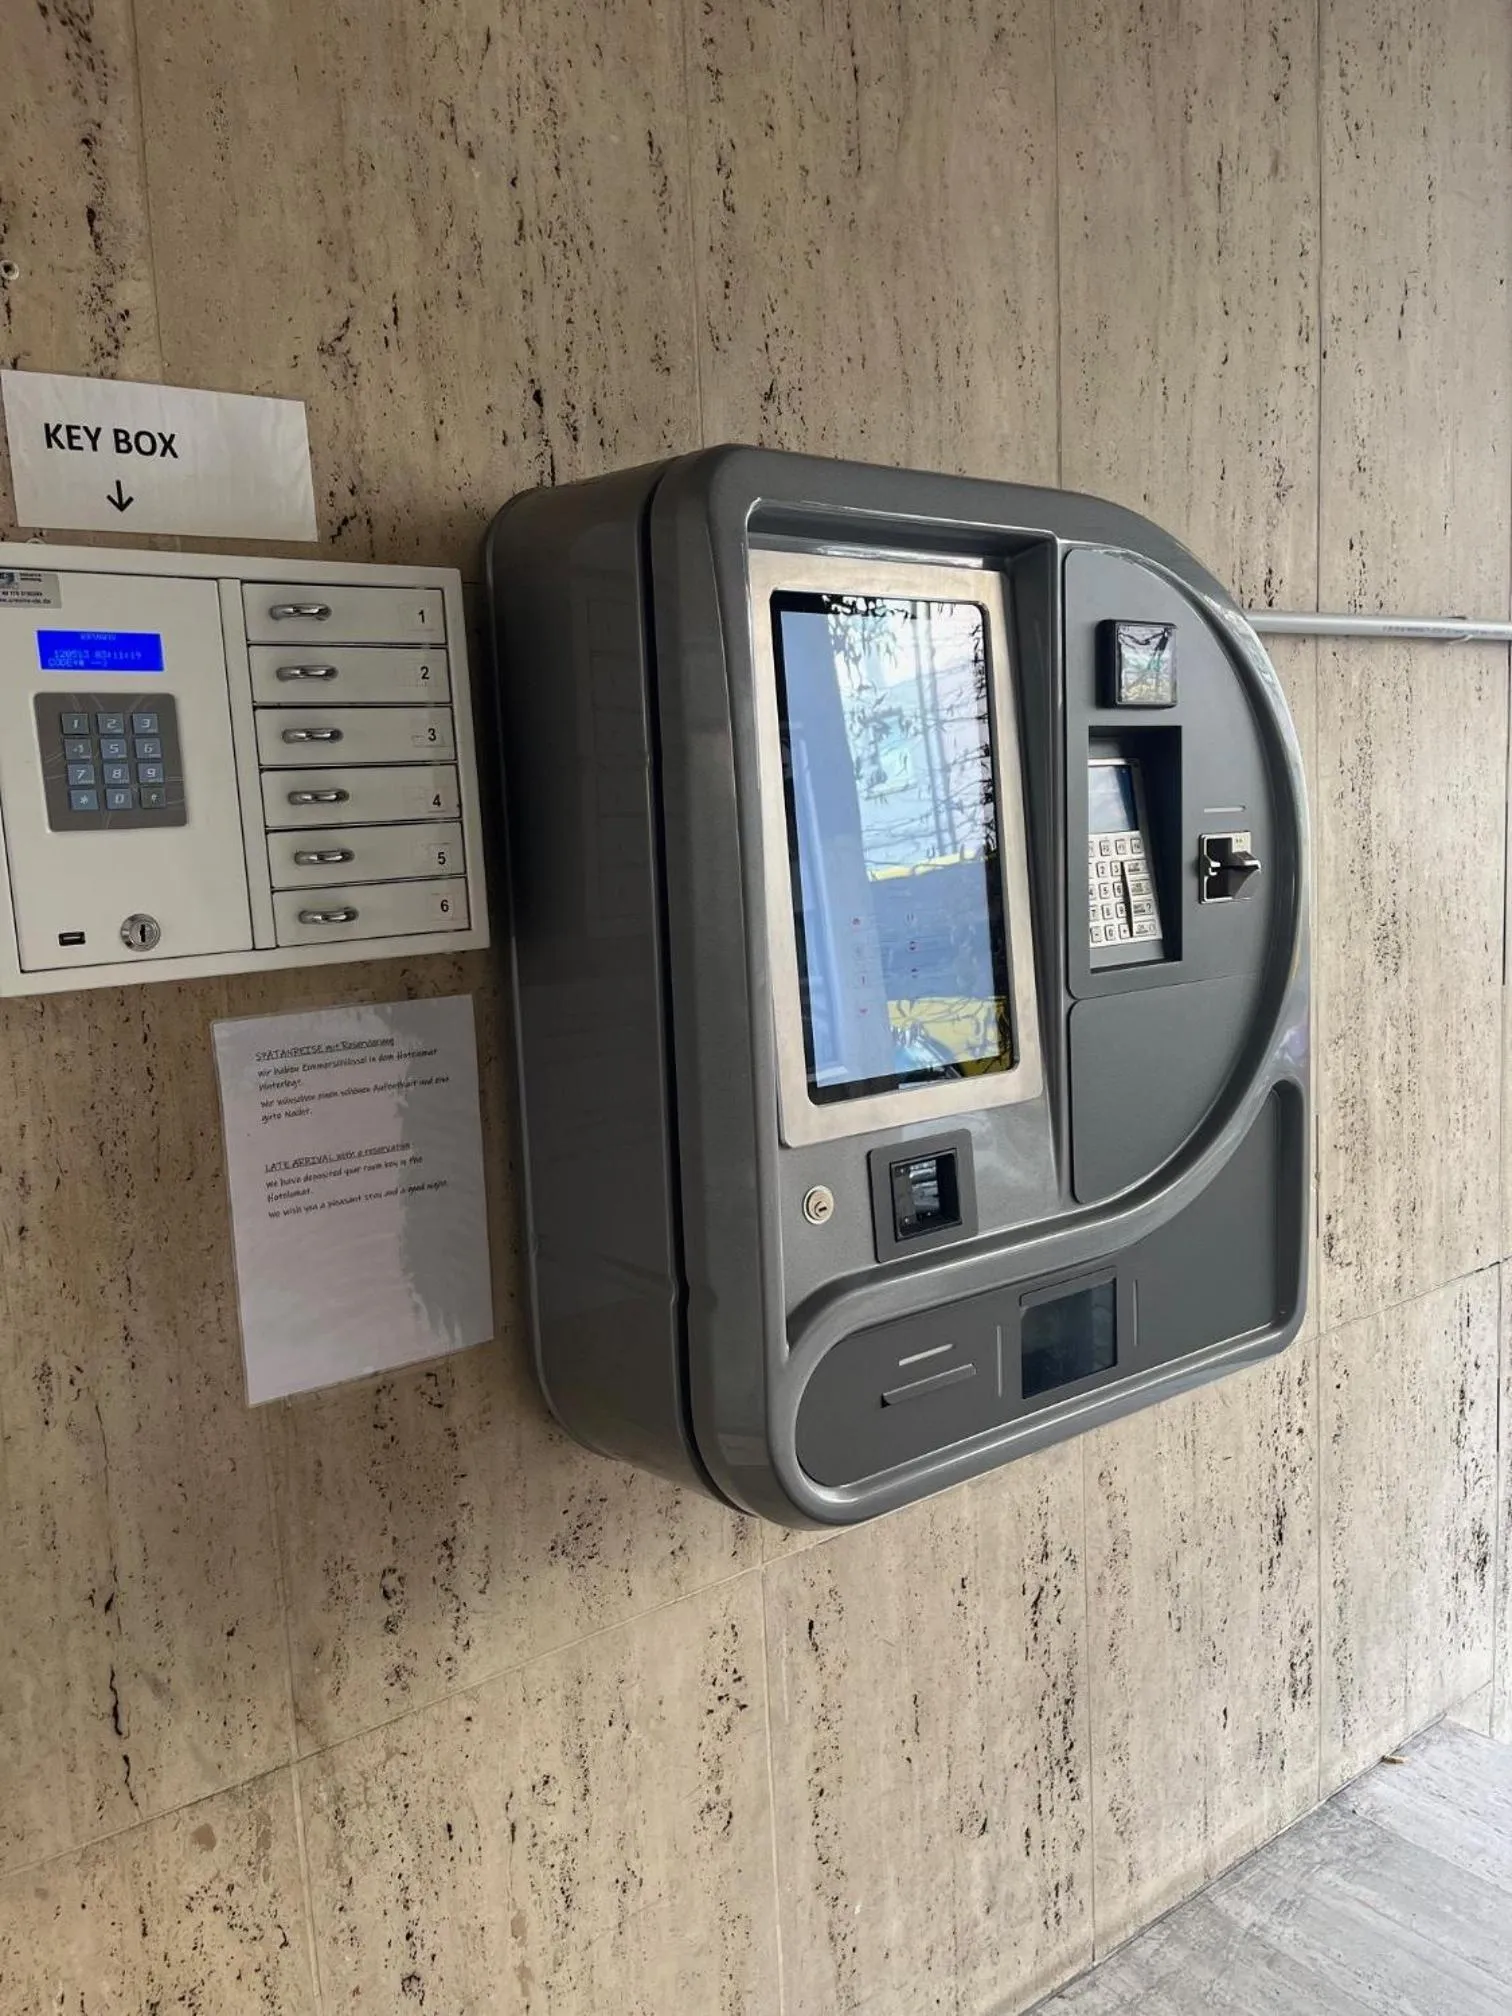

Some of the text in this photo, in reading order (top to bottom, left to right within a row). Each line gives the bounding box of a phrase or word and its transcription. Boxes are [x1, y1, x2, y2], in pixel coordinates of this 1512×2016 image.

[43, 422, 179, 459] KEY BOX
[418, 610, 426, 624] 1
[420, 666, 430, 680] 2
[106, 718, 117, 729] 2
[141, 718, 151, 728] 3
[427, 728, 437, 742] 3
[109, 743, 119, 754] 5
[144, 743, 154, 754] 6
[76, 768, 157, 780] 7 8 9
[115, 794, 125, 804] 0
[432, 794, 442, 807] 4
[437, 852, 446, 865] 5
[441, 899, 449, 913] 6
[264, 1161, 292, 1173] LATE
[292, 1155, 333, 1168] ARRIVAL
[279, 1177, 301, 1187] have
[282, 1206, 302, 1216] wish
